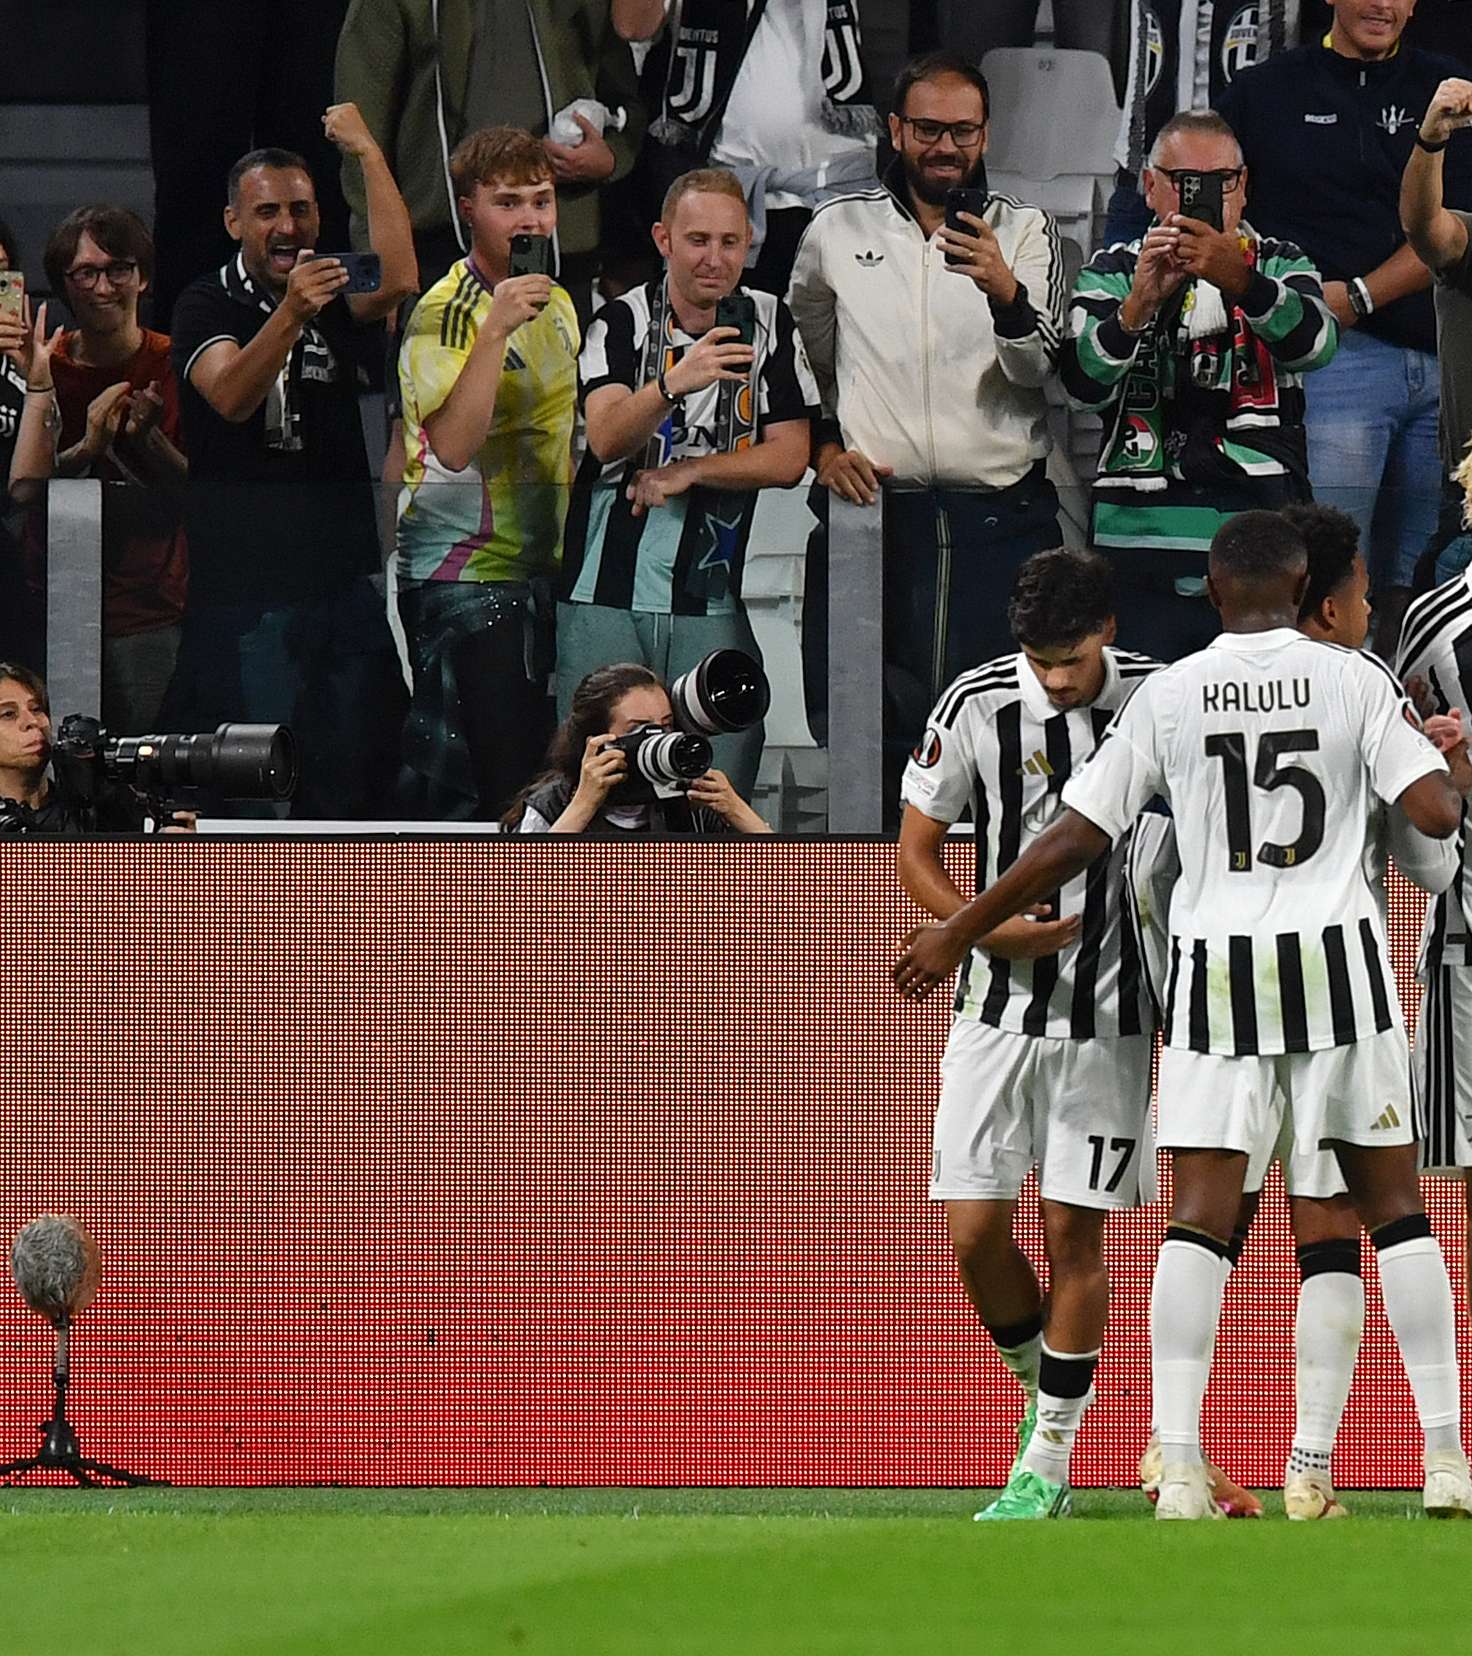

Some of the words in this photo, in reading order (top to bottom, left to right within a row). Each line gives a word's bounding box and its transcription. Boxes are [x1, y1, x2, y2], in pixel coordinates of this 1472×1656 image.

[1203, 677, 1312, 713] KALULU
[1204, 728, 1327, 873] 15
[1088, 1134, 1137, 1193] 17
